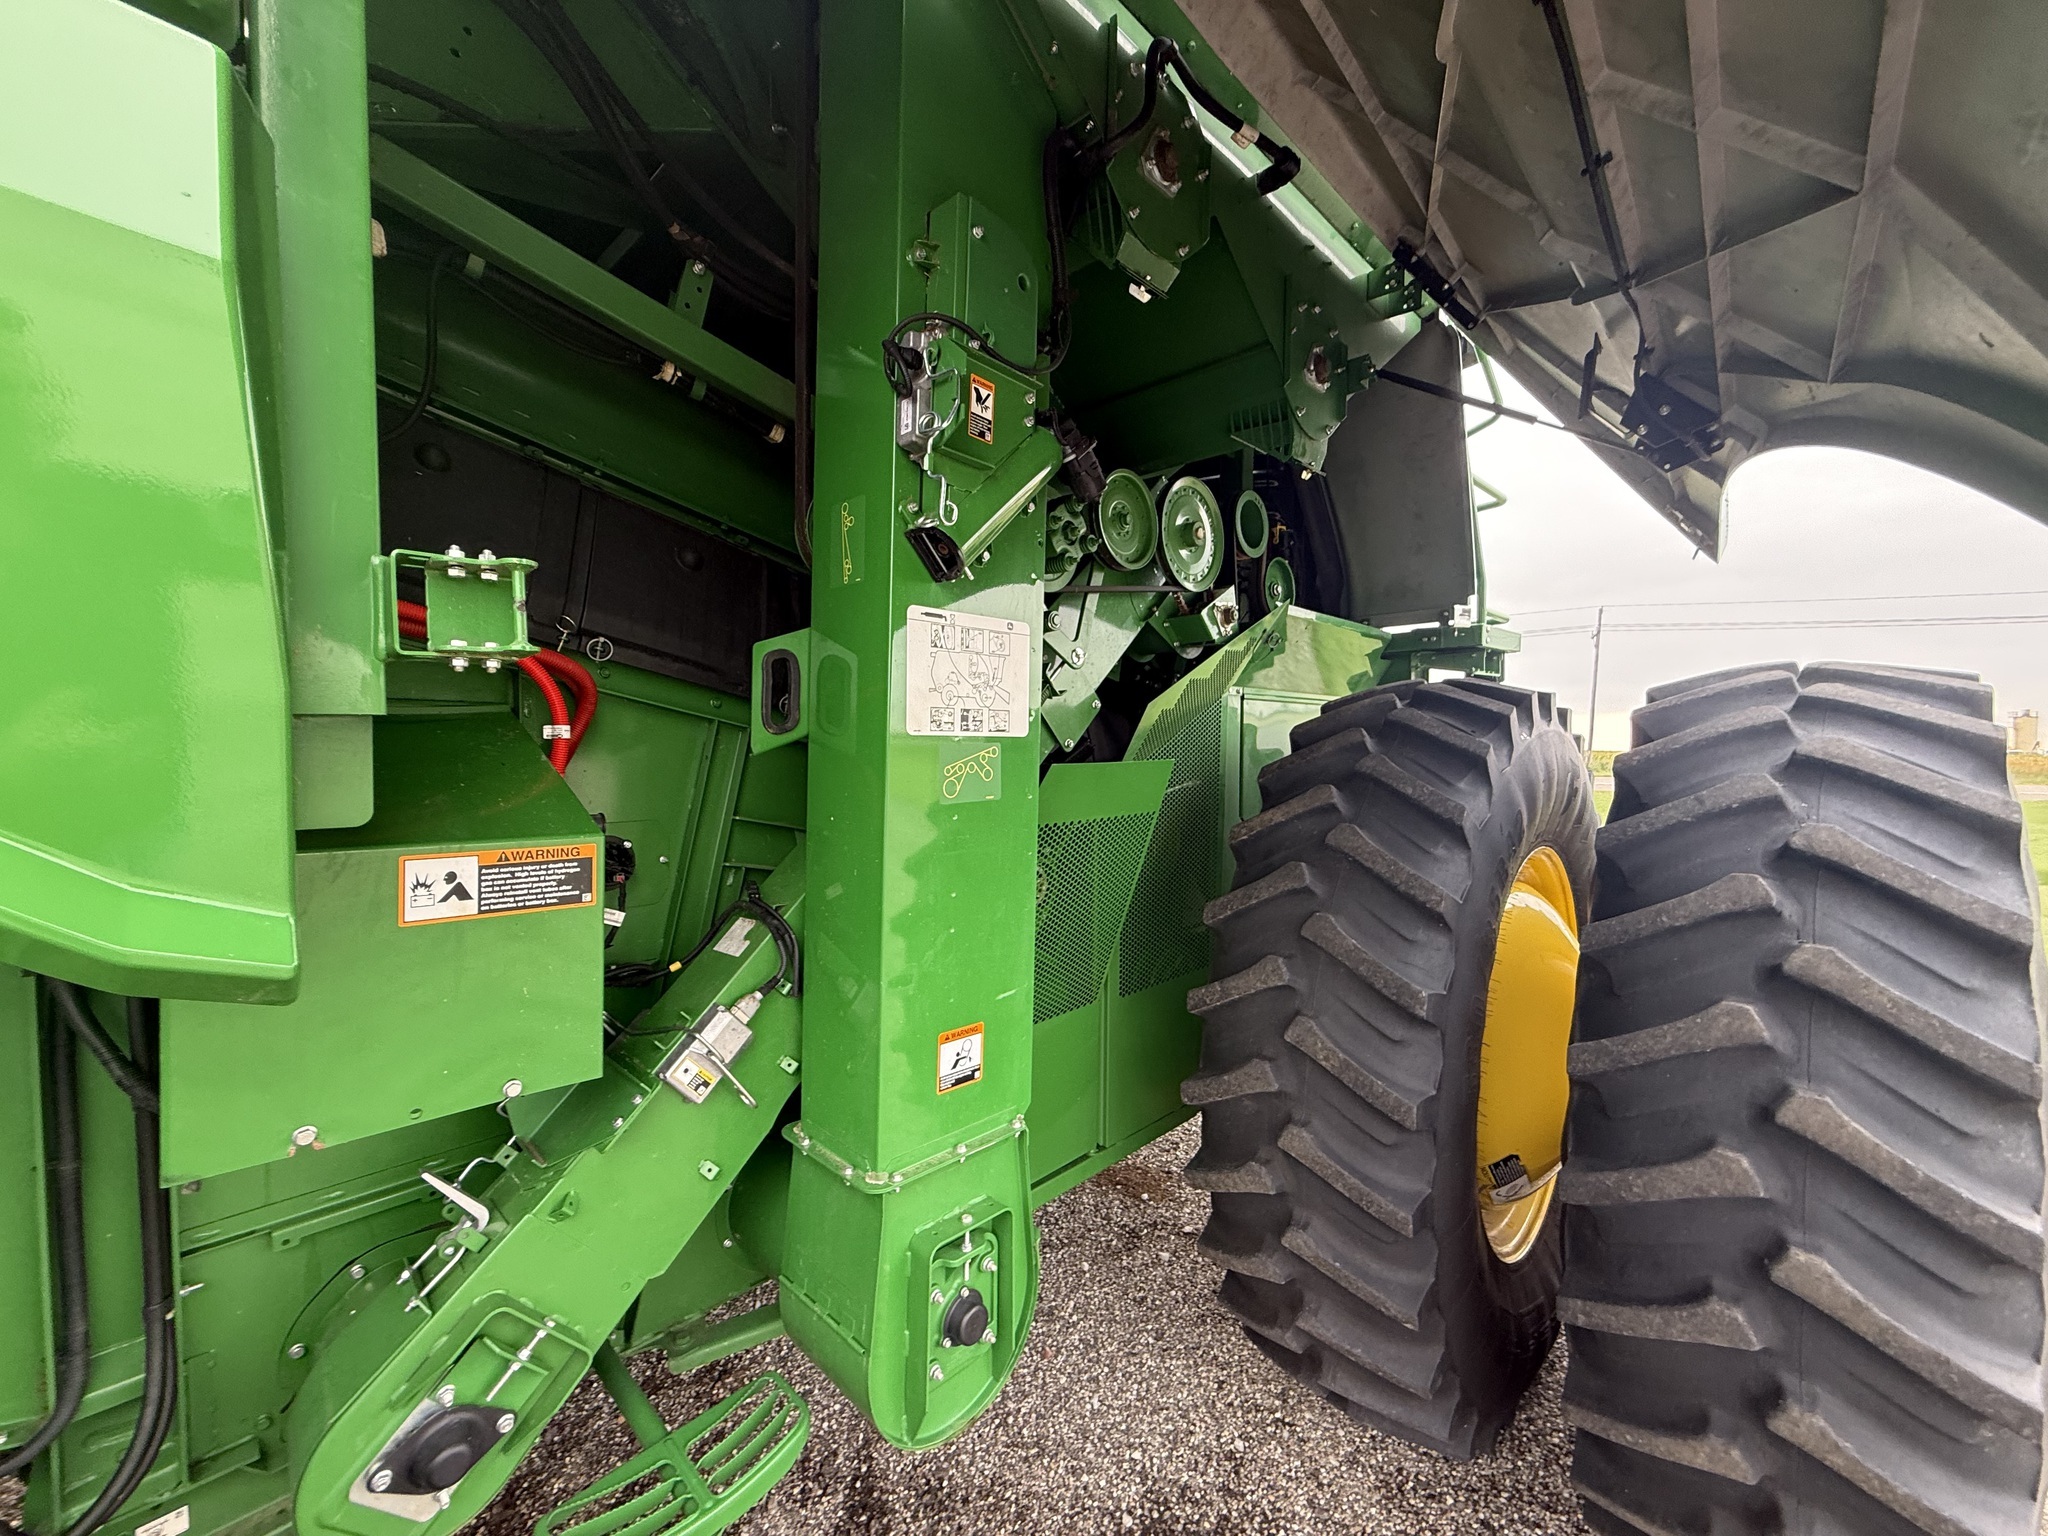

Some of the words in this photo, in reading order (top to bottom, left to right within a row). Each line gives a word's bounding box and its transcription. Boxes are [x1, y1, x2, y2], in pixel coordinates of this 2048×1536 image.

[511, 847, 580, 861] WARNING
[480, 897, 514, 906] performing
[951, 1026, 978, 1038] WARNING
